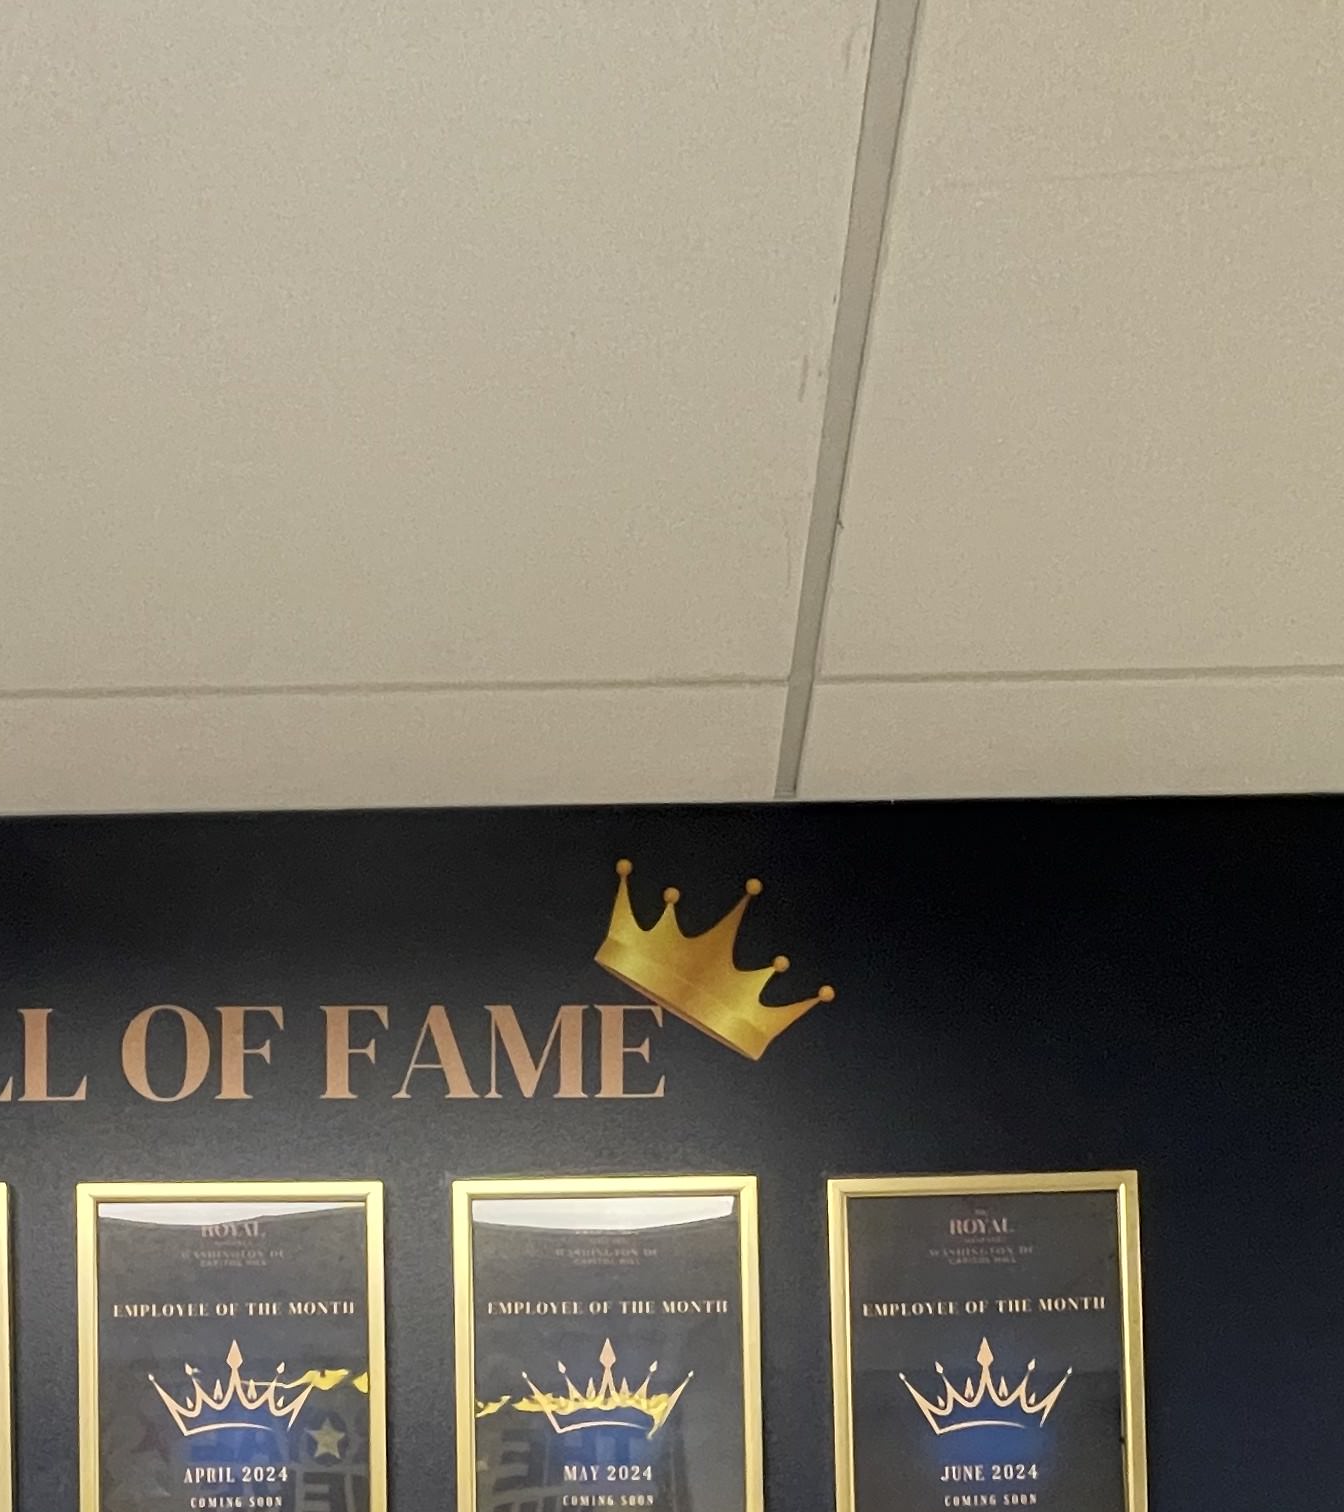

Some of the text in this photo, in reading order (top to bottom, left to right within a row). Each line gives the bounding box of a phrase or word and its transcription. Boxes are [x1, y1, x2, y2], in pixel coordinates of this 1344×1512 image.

[122, 1006, 283, 1102] OF
[320, 1003, 667, 1099] FAME
[950, 1218, 1015, 1235] ROYAL
[113, 1302, 355, 1317] EMPLOYEE OF THE MONTH
[488, 1301, 727, 1314] EMPLOYEE OF THE MONTH
[863, 1297, 1105, 1316] EMPLOYEE OF THE MONTH
[184, 1466, 287, 1483] APRIL 2024
[565, 1465, 651, 1481] MAY 2024
[941, 1464, 1037, 1481] JUNE 2024
[191, 1496, 282, 1508] COMING SOON
[563, 1495, 653, 1506] COMING SOON
[945, 1494, 1036, 1506] COMING SOON
